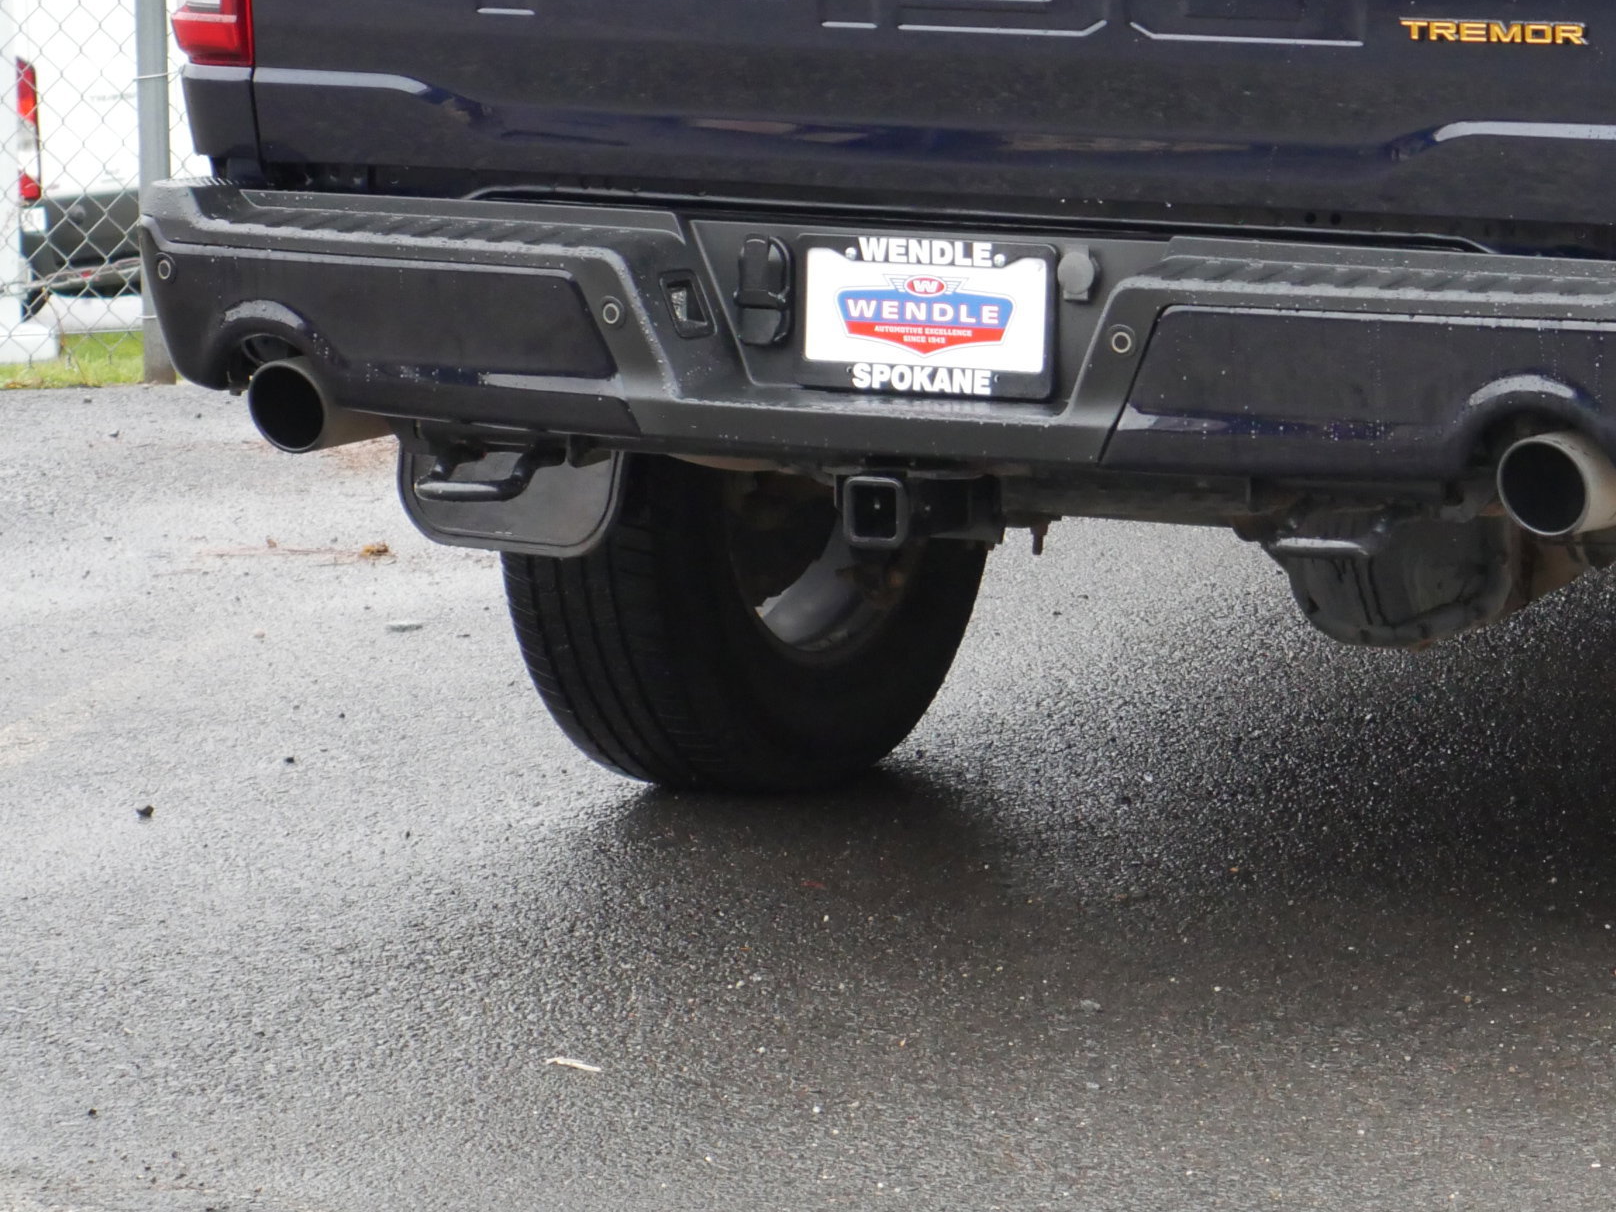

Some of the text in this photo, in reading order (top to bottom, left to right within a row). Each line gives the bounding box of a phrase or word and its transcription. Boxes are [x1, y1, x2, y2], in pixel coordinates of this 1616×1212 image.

[1400, 19, 1588, 45] TREMOR
[858, 237, 993, 267] WENDLE
[846, 299, 1000, 324] WENDLE
[874, 325, 972, 337] AUTOMOTIVE EXCELLENCE
[903, 335, 926, 343] SINCE
[852, 362, 992, 395] SPOKANE
